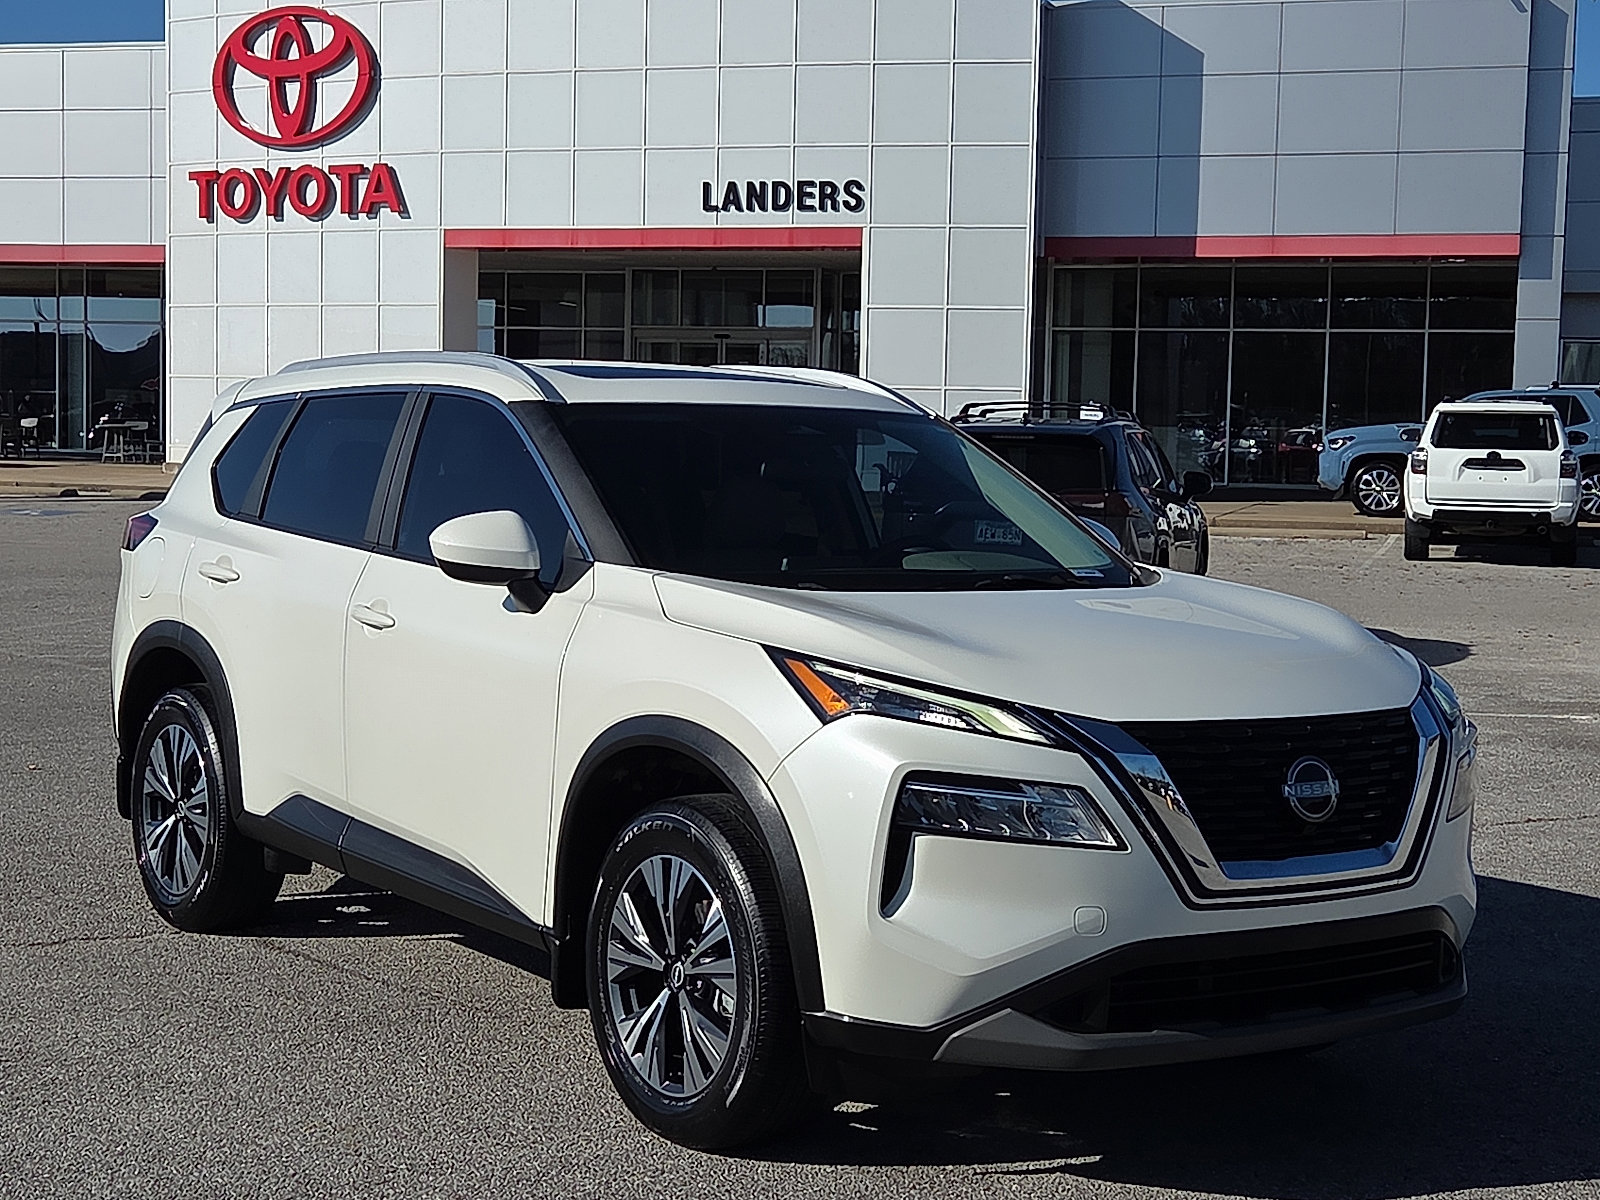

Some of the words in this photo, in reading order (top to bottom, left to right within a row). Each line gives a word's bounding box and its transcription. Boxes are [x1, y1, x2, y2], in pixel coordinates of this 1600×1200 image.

[188, 163, 404, 220] TOYOTA
[702, 179, 866, 213] LANDERS
[1284, 780, 1340, 796] NISSAN
